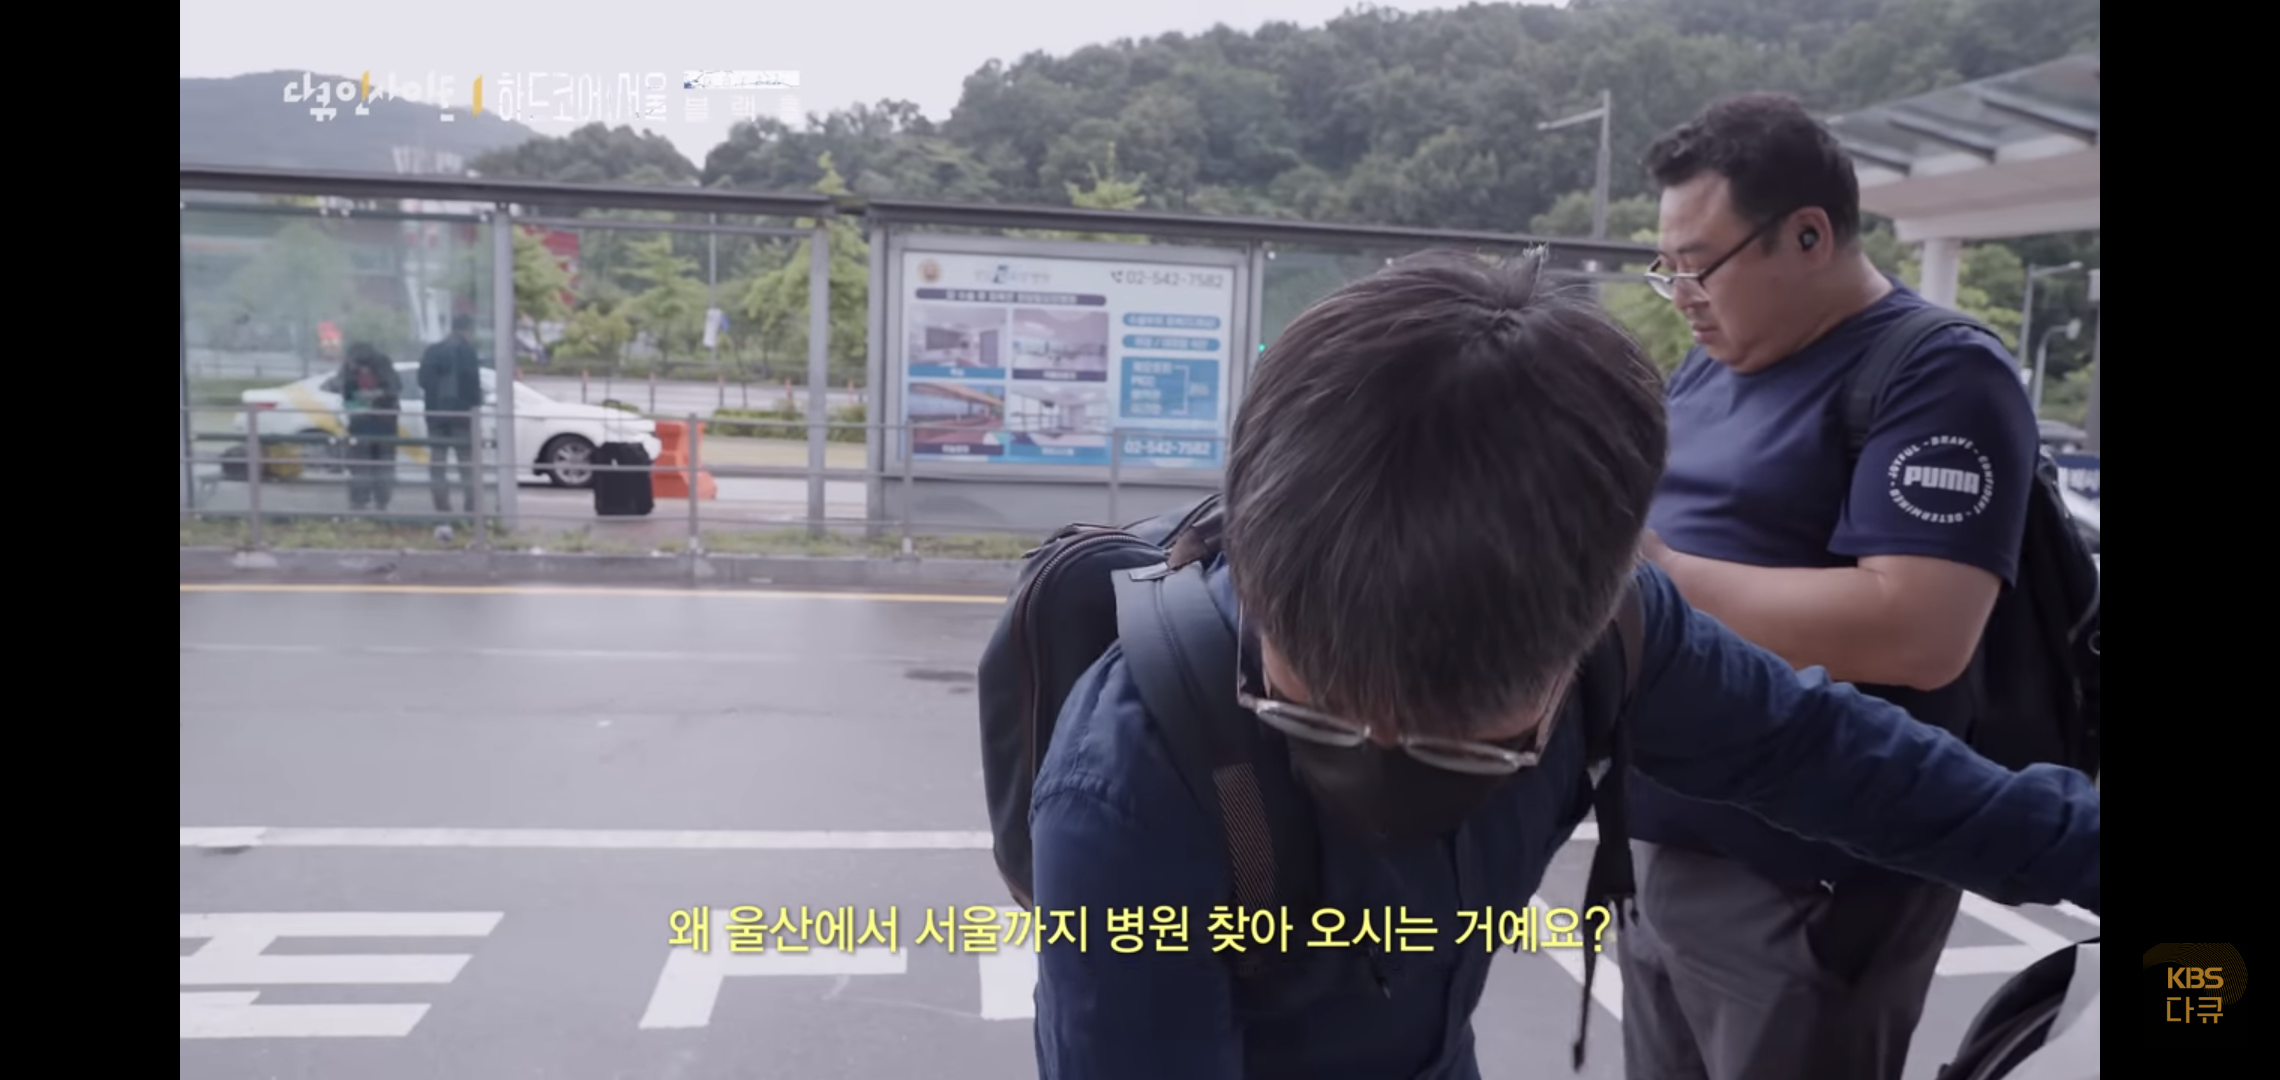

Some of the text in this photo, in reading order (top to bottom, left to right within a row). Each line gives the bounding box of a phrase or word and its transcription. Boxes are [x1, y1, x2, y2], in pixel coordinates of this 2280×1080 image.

[1126, 270, 1224, 289] 02-542-7582
[1930, 435, 1974, 449] BRAVE
[1888, 444, 1921, 478] JOYFUL
[1903, 465, 1981, 496] PUMA
[1973, 455, 1994, 515] CONFIDENT
[1889, 488, 1964, 523] DETERMINED
